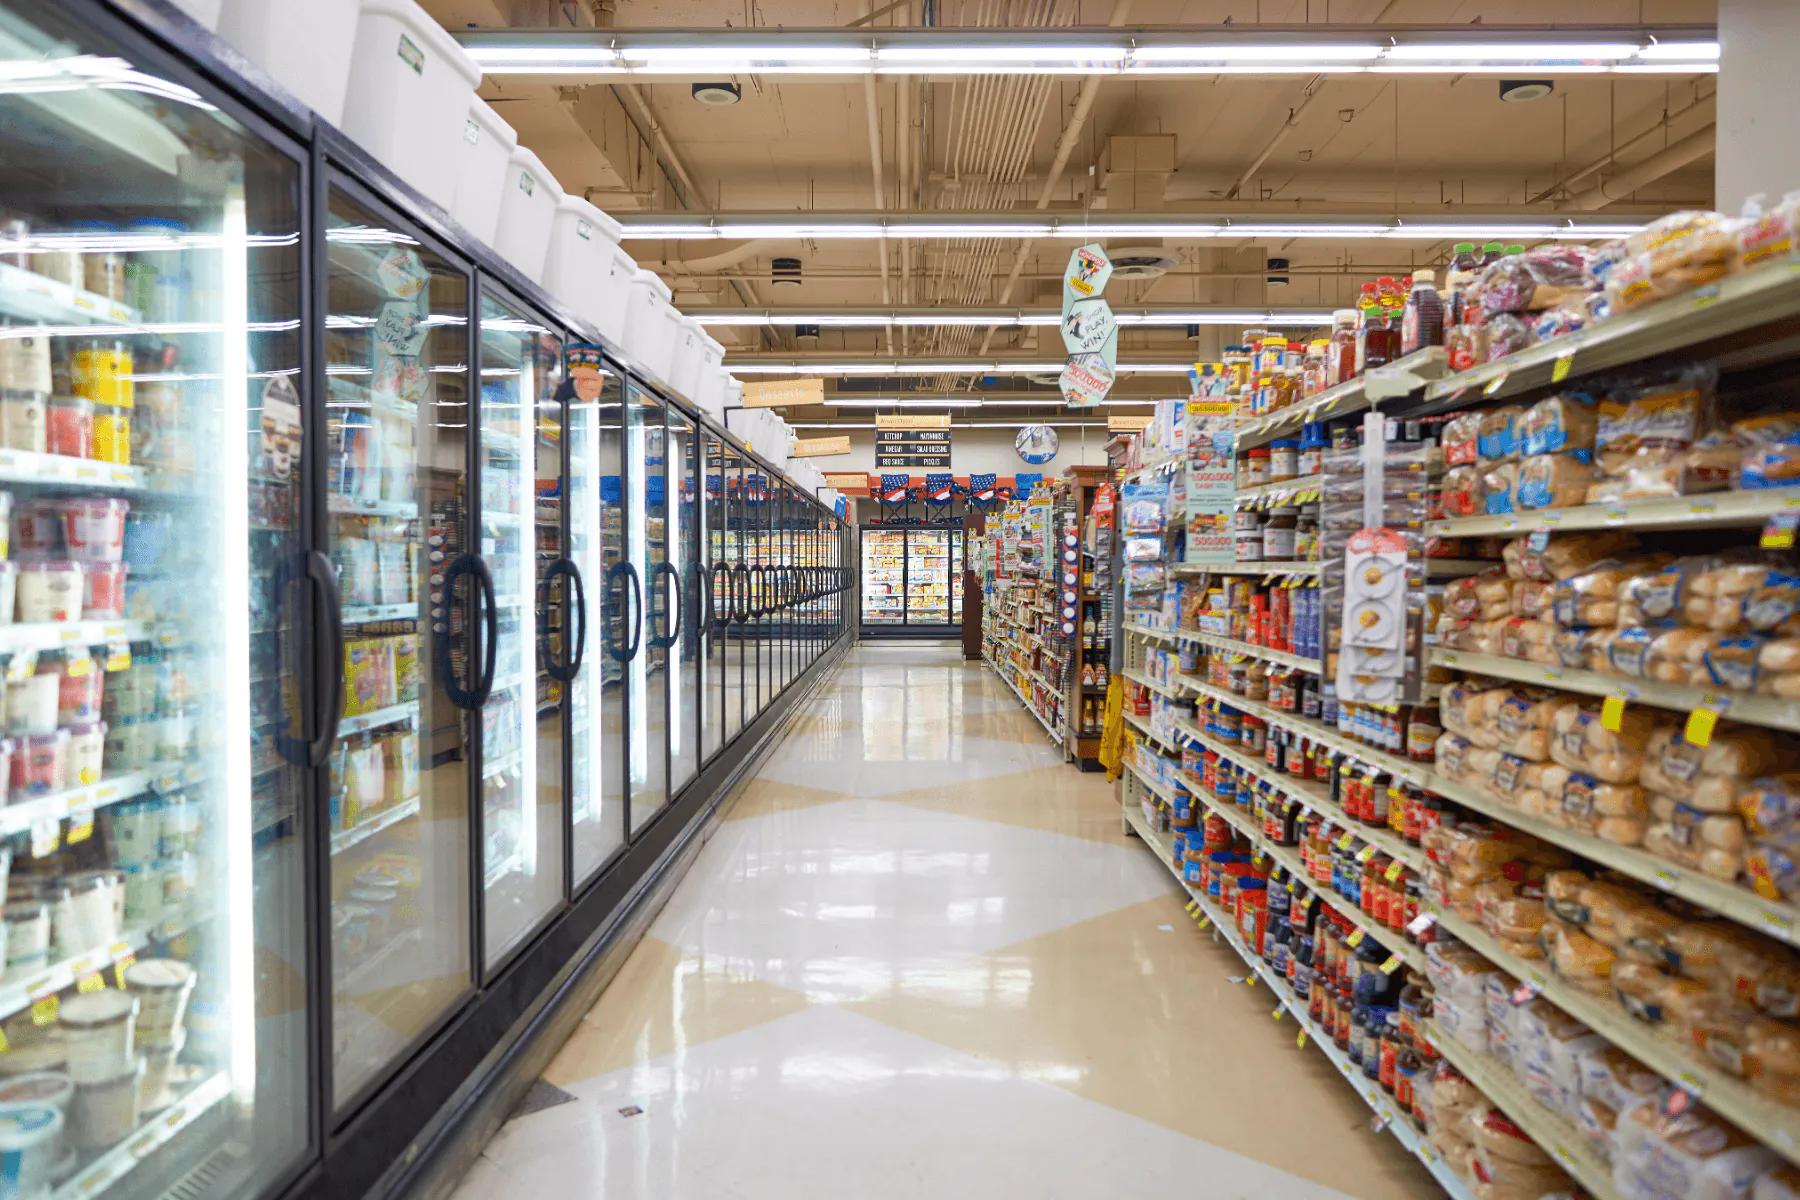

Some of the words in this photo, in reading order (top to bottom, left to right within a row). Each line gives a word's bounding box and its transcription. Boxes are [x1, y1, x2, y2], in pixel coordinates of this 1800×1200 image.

[1085, 316, 1108, 334] PLAY,
[1080, 330, 1106, 349] WIN!
[759, 388, 805, 400] Desserts
[885, 445, 903, 453] VINEGAR
[916, 445, 928, 453] SALAD
[929, 445, 948, 453] DRESSING
[882, 458, 891, 466] BBQ
